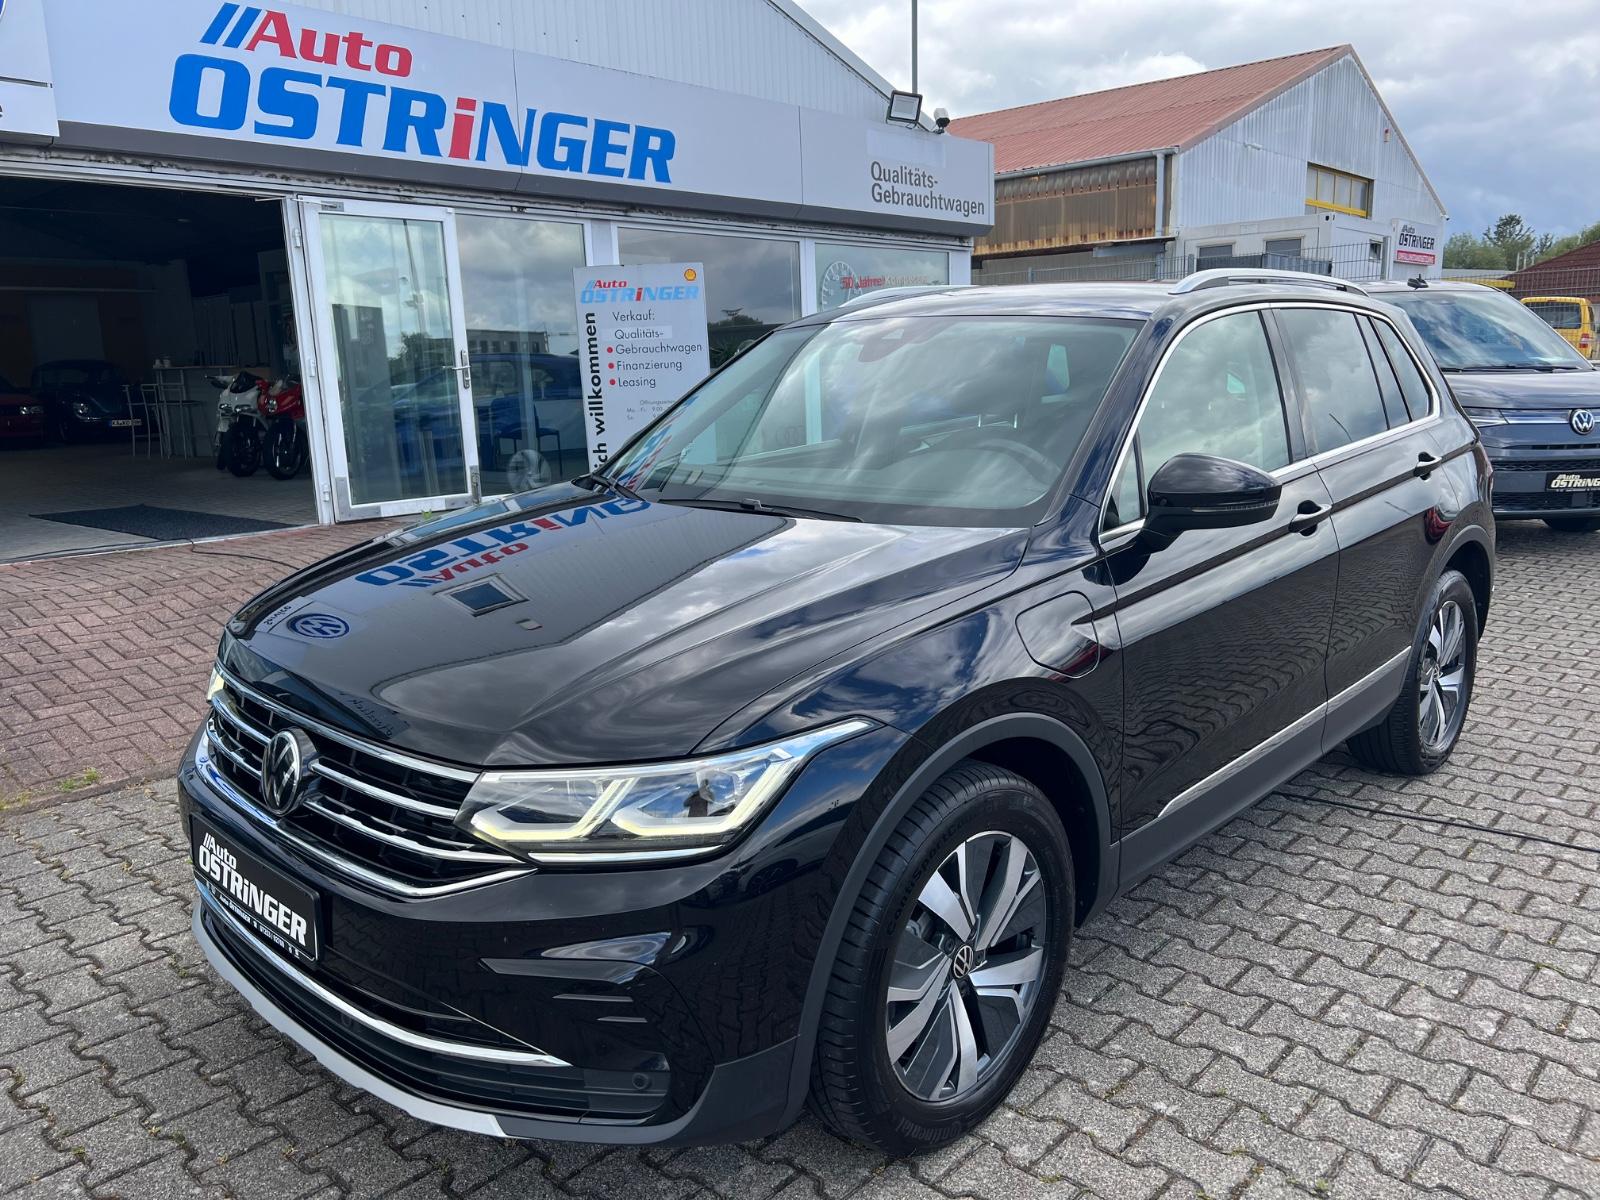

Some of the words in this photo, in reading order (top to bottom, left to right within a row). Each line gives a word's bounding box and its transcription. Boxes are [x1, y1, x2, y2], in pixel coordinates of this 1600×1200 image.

[246, 10, 412, 77] Auto
[870, 161, 938, 188] Qualitäts-
[871, 182, 985, 217] Gebrauchtwagen
[593, 279, 627, 289] Auto
[612, 309, 656, 322] Verkauf:
[614, 328, 664, 341] Qualitäts-
[615, 341, 702, 355] Gebrauchtwagen
[616, 359, 683, 372] Finanzierung
[584, 312, 608, 436] willkommen
[618, 376, 657, 389] Leasing
[207, 835, 237, 870] Auto
